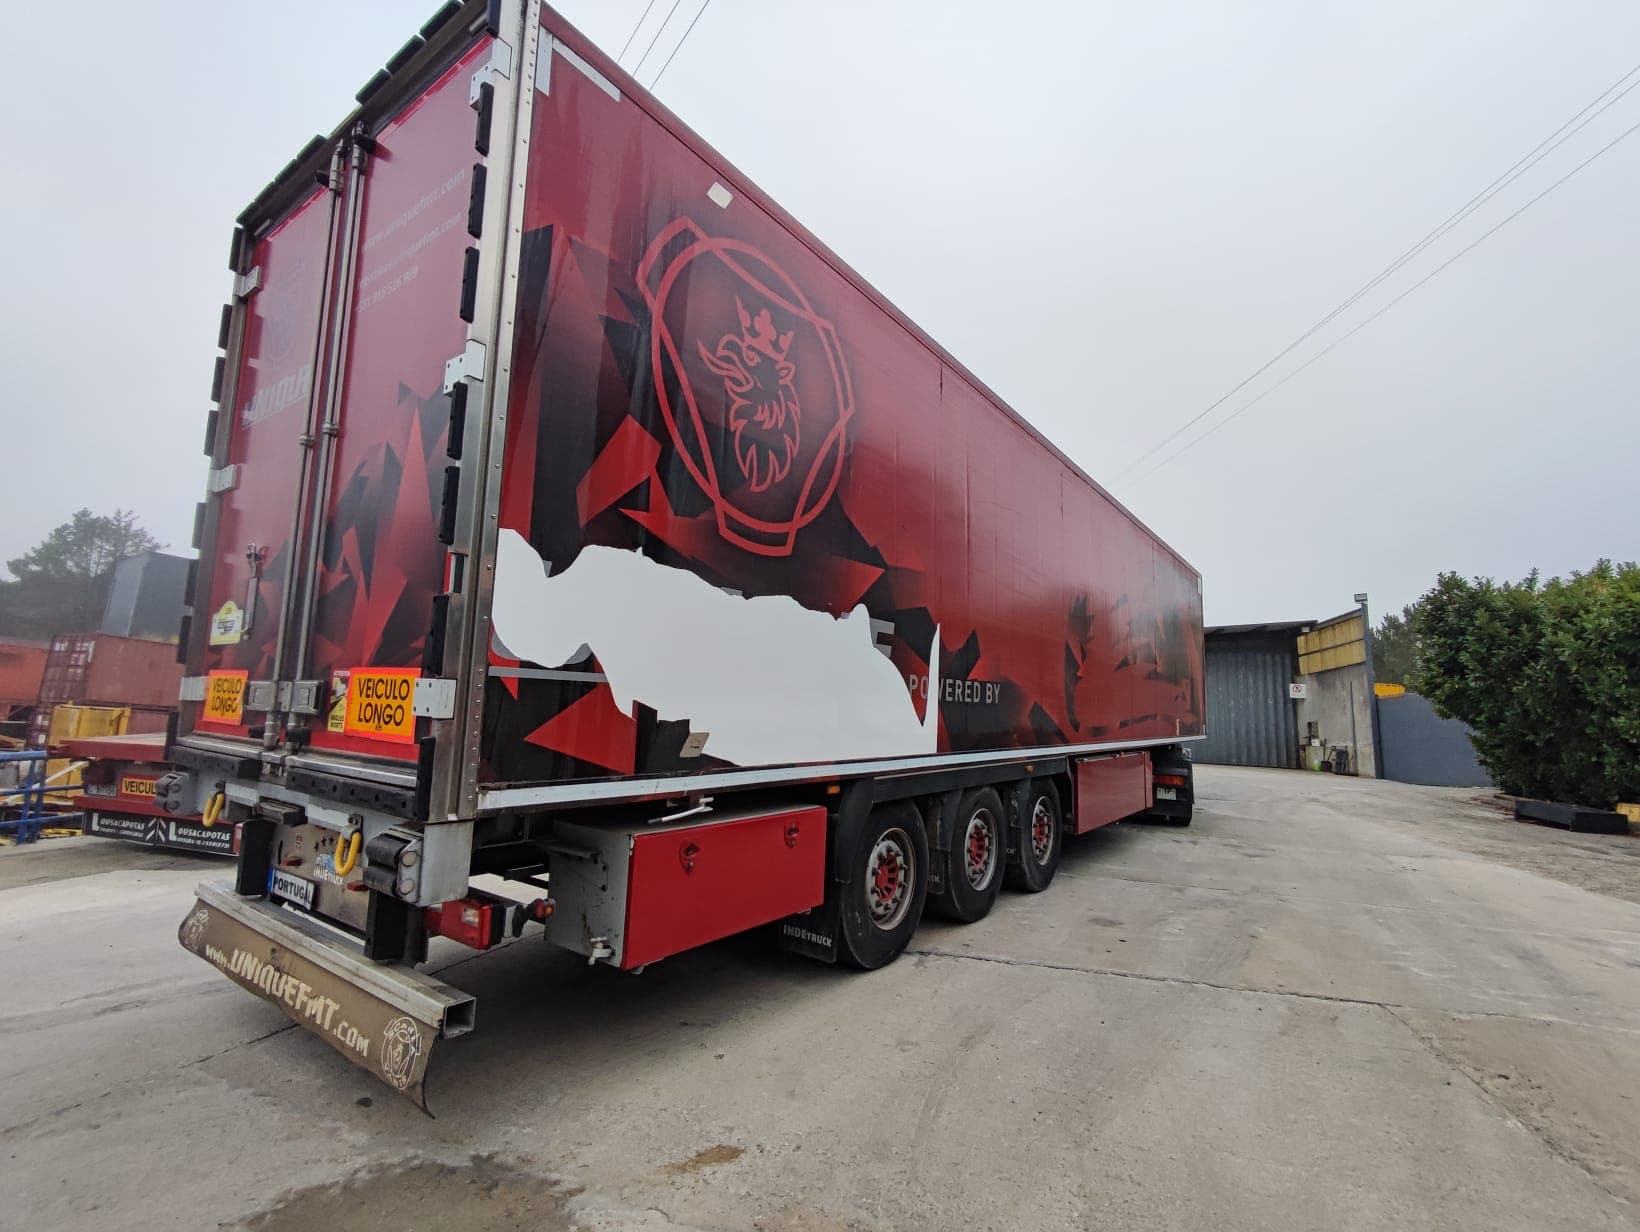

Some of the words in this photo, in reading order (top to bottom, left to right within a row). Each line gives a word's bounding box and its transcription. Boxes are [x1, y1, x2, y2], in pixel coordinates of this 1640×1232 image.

[212, 677, 241, 694] VEICULO
[358, 677, 410, 701] VEICULO
[985, 683, 1001, 705] BY
[211, 695, 238, 714] LONGO
[357, 703, 405, 727] LONGO
[272, 876, 312, 905] PORTUGAL
[783, 924, 833, 948] INDETRUCK
